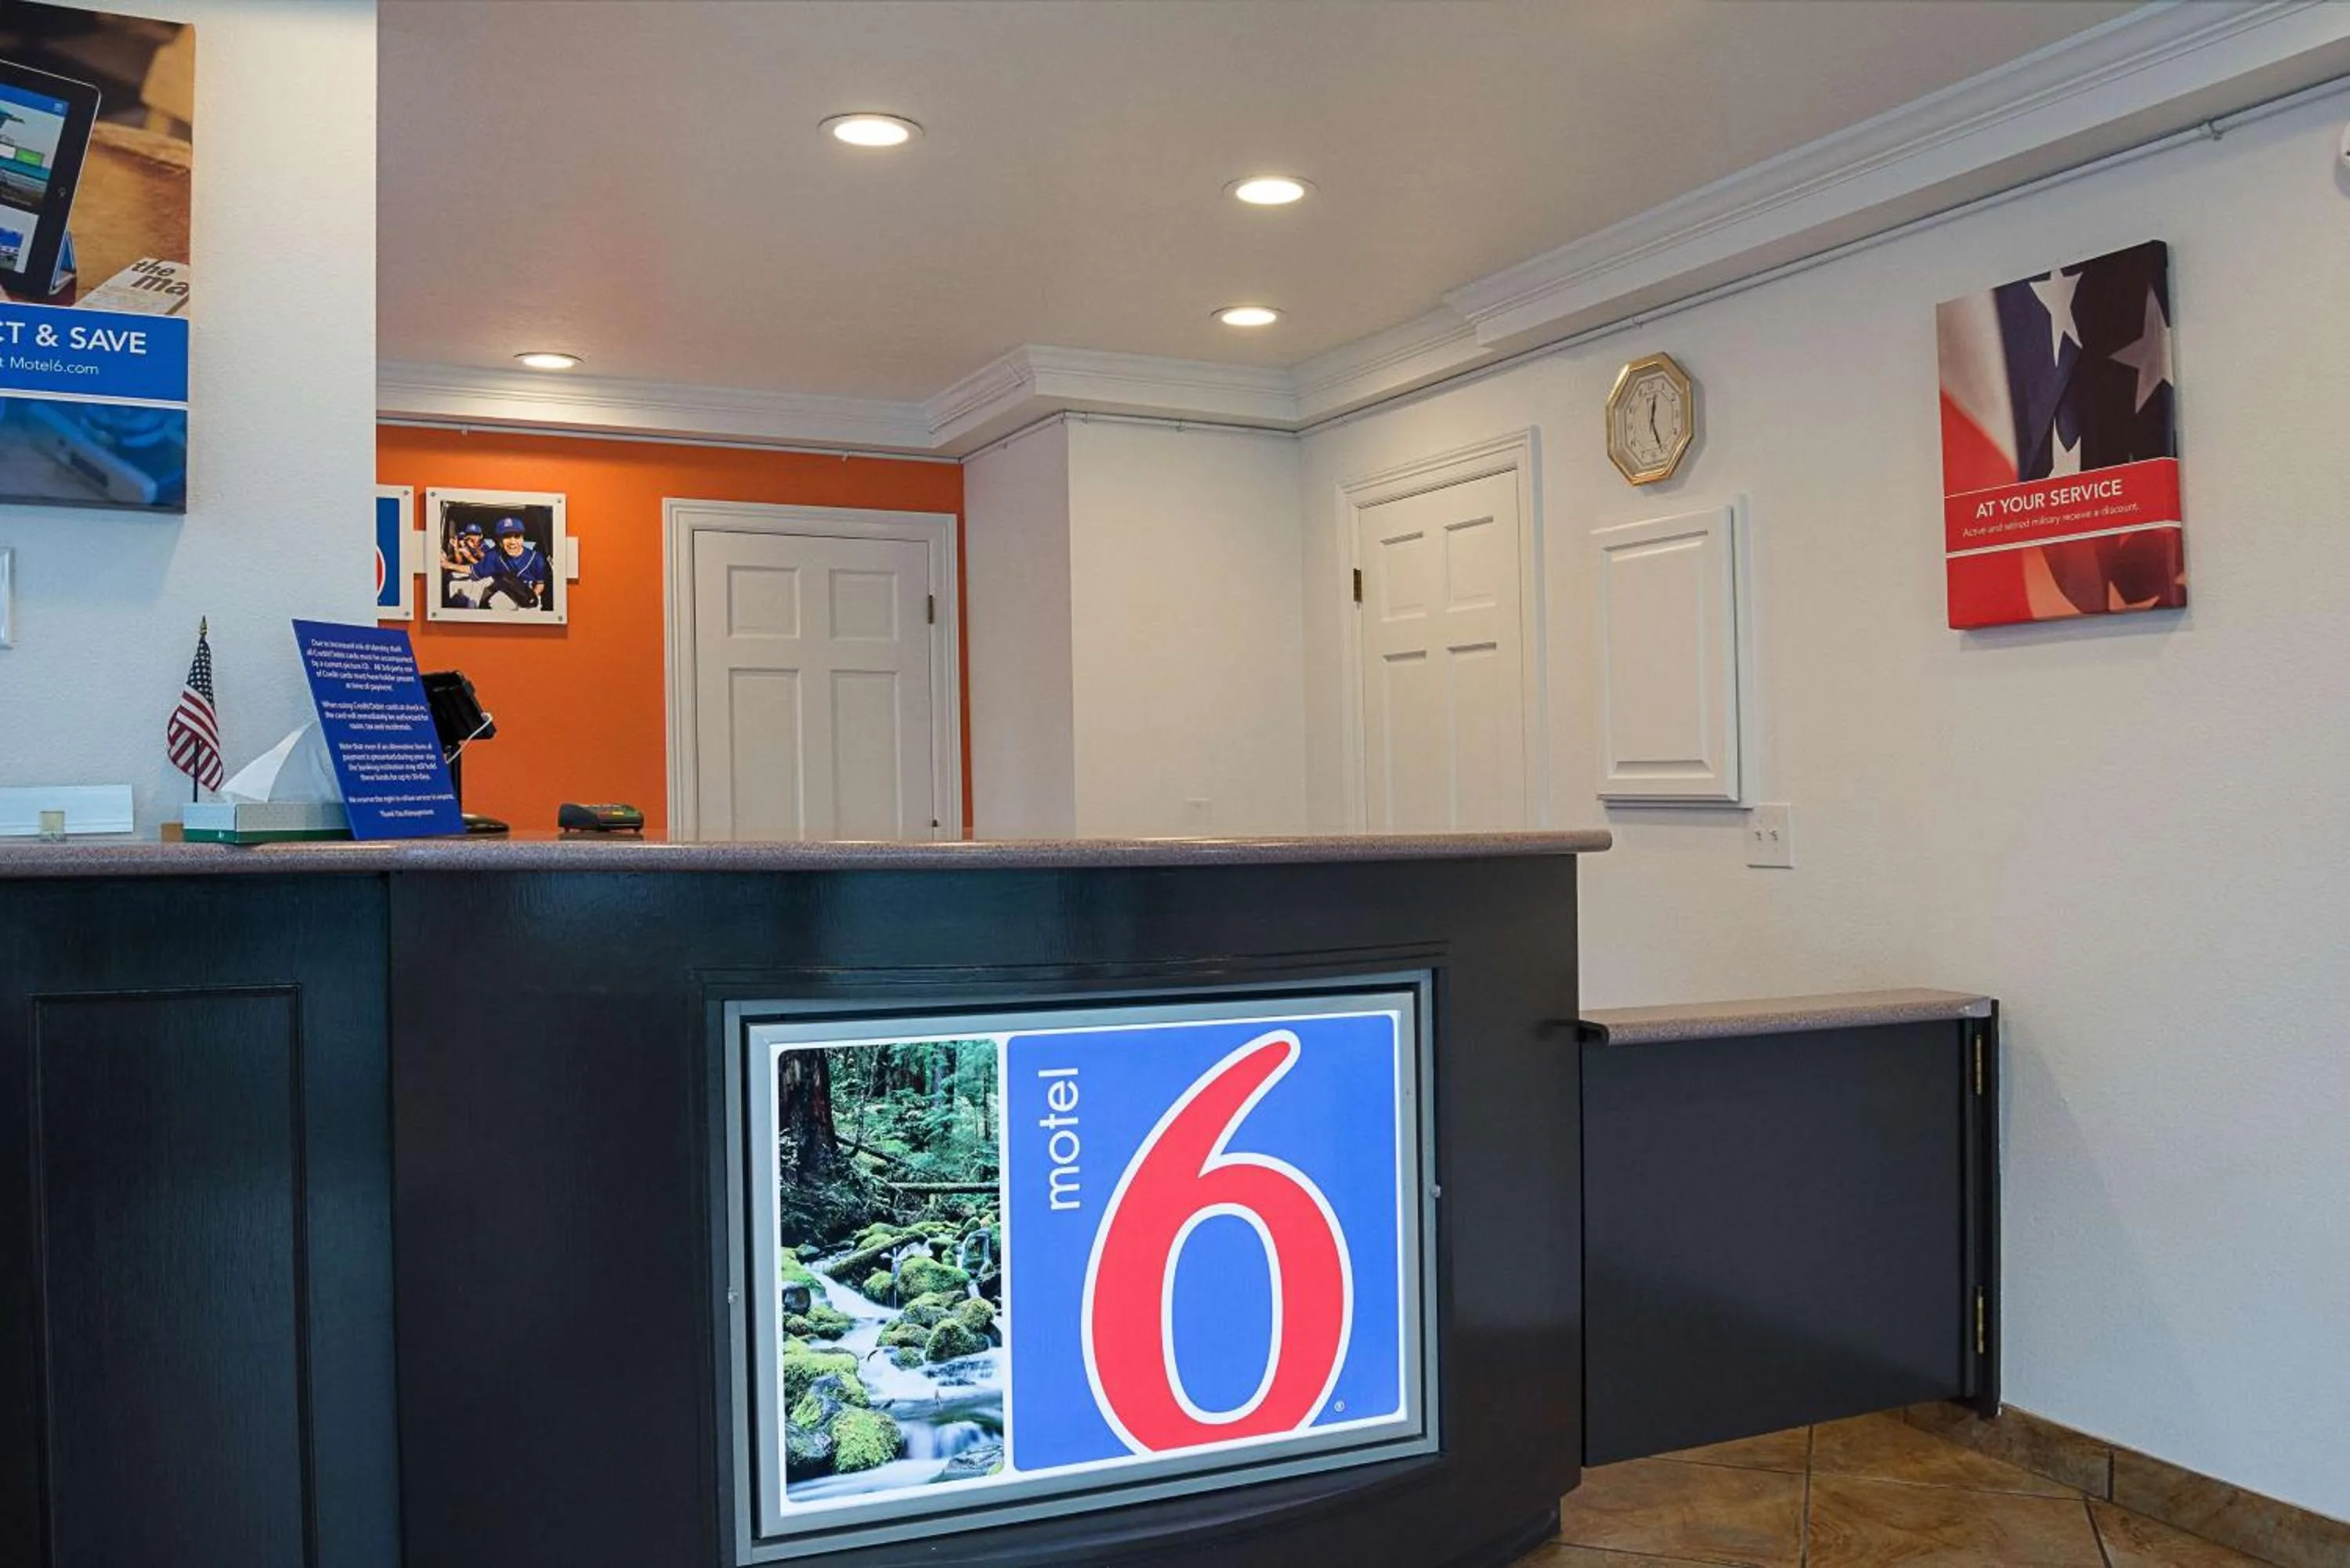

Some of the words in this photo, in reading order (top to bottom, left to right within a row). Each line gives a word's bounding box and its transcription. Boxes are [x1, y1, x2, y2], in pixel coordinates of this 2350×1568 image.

[131, 259, 176, 276] the
[35, 323, 60, 348] &
[69, 326, 147, 354] SAVE
[9, 356, 100, 375] Motel6.com
[1976, 501, 1996, 518] AT
[1998, 493, 2046, 515] YOUR
[2049, 479, 2124, 507] SERVICE
[1987, 522, 2004, 533] and
[2030, 515, 2061, 529] military
[1038, 1067, 1080, 1211] motel
[1080, 1028, 1354, 1457] 6
